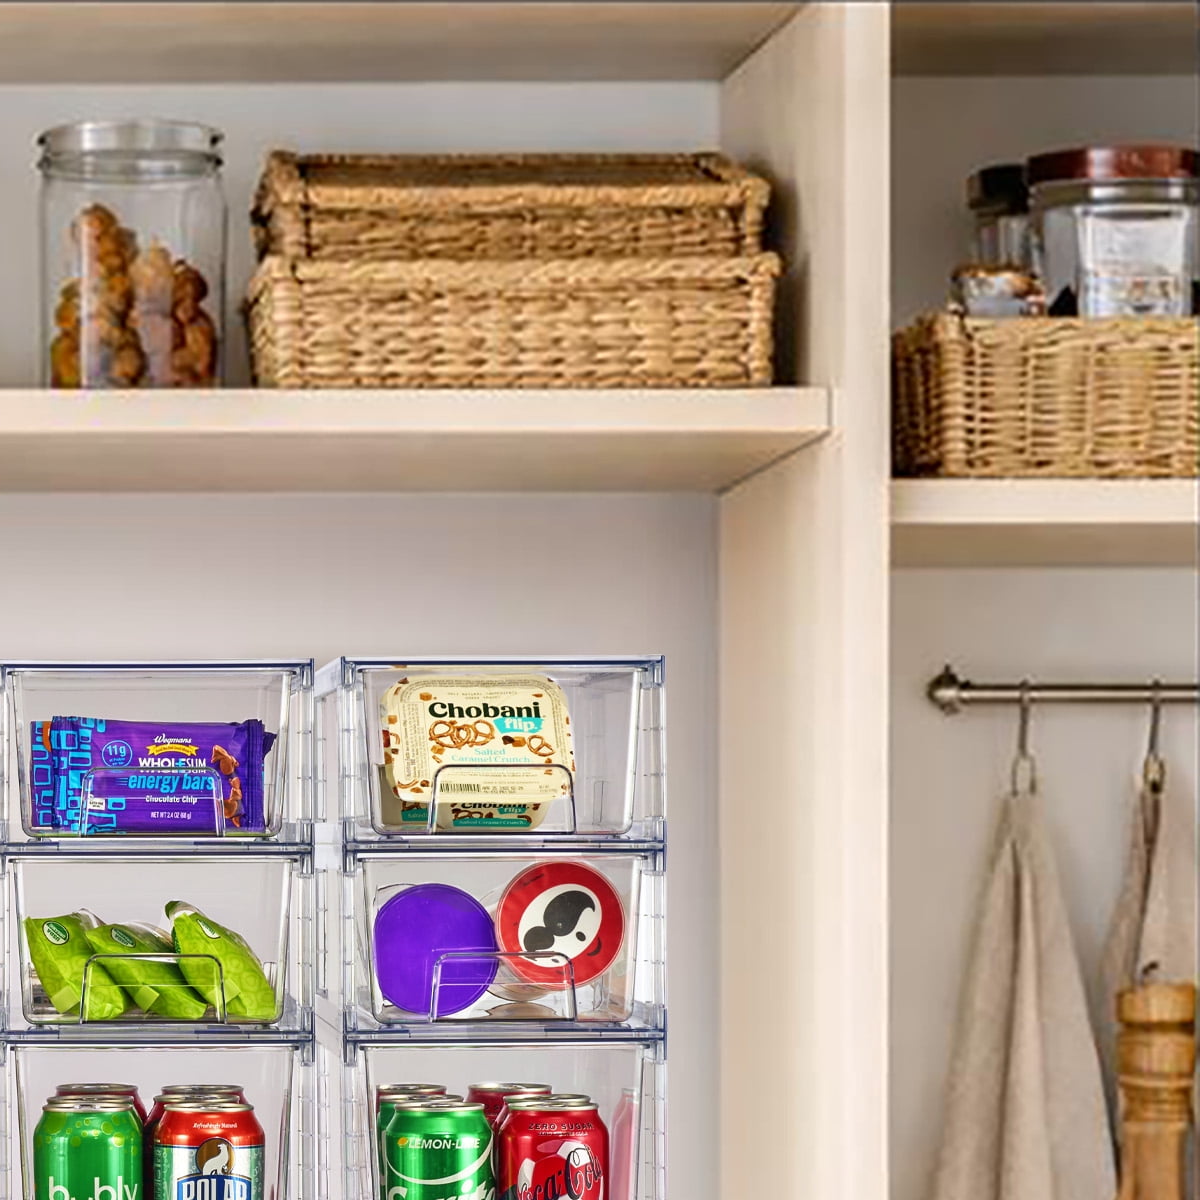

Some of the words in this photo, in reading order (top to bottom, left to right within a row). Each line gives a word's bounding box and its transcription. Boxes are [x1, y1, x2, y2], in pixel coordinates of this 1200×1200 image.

[428, 701, 541, 718] Chobani
[153, 733, 192, 745] Wegmans
[107, 745, 127, 757] 11g
[451, 755, 492, 763] Caramel
[128, 775, 180, 793] energy
[182, 773, 215, 790] bars
[145, 794, 180, 803] Chocolate
[528, 1122, 556, 1130] ZERO
[561, 1122, 593, 1131] SUGAR
